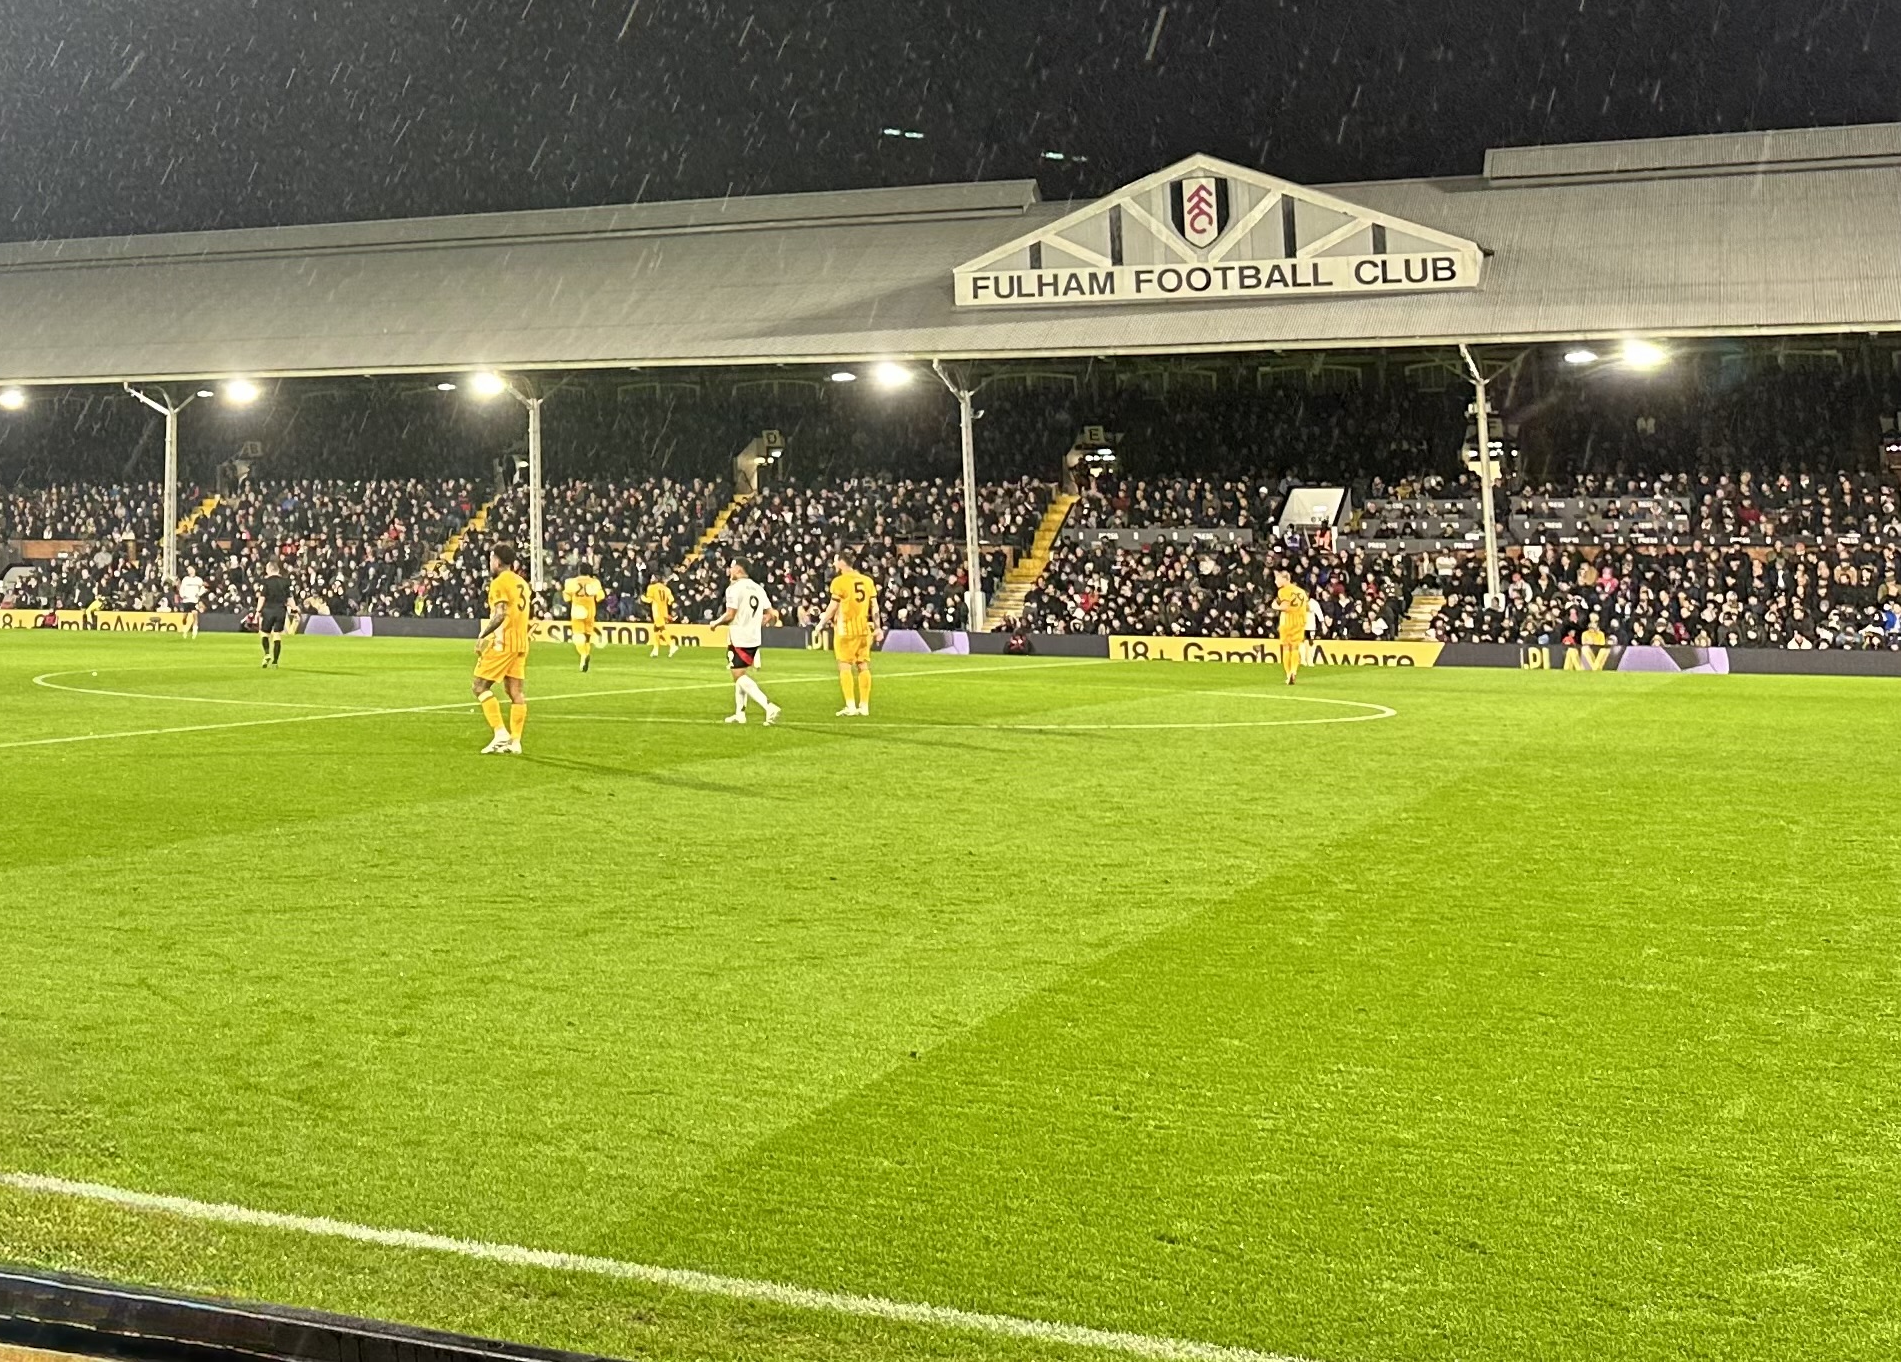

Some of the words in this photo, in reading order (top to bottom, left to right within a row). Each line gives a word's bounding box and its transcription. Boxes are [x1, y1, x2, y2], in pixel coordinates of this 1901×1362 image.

[972, 271, 1116, 300] FULHAM
[1134, 262, 1334, 294] FOOTBALL
[1354, 256, 1457, 286] CLUB
[517, 584, 527, 612] 3
[854, 582, 865, 603] 5
[1290, 592, 1305, 607] 29
[749, 595, 759, 618] 9
[1119, 641, 1173, 661] 18+
